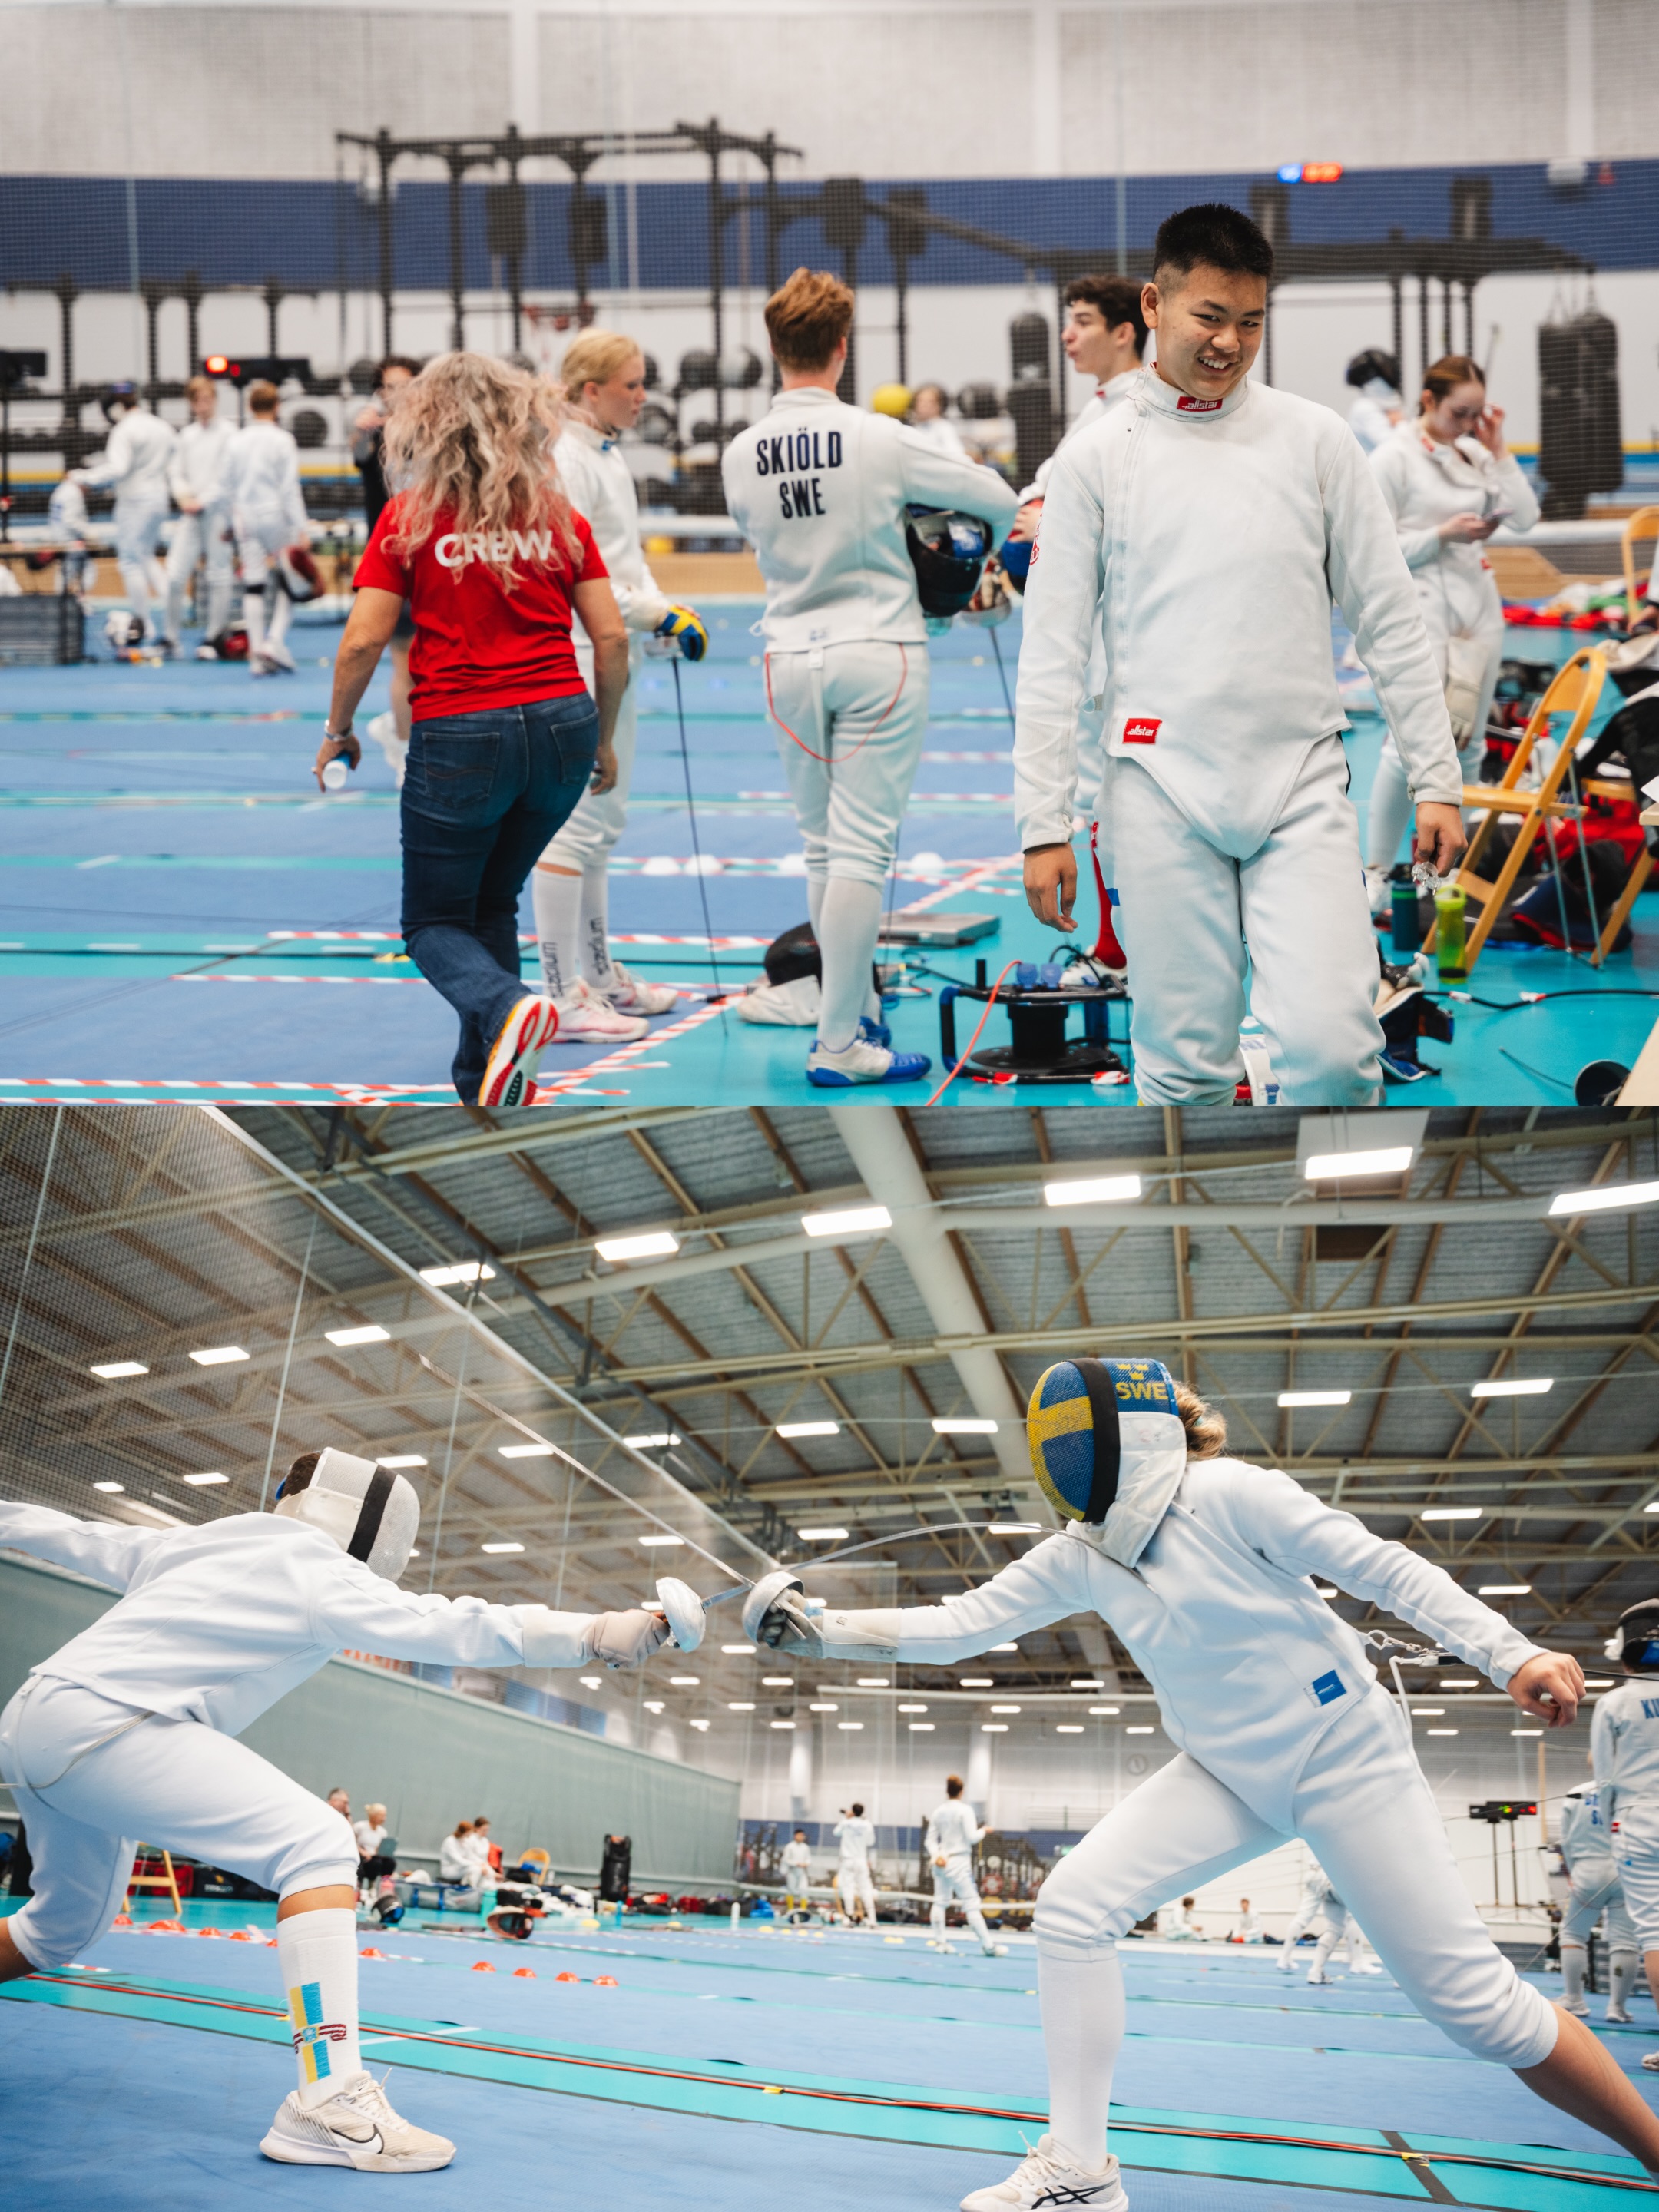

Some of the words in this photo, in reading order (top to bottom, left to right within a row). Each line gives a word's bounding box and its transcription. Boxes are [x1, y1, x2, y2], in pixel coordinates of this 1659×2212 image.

[1187, 399, 1219, 409] allstar
[757, 427, 842, 476] SKIÖLD
[780, 478, 826, 519] SWE
[435, 530, 553, 567] CREW
[1128, 724, 1155, 737] allstar
[1116, 1381, 1168, 1400] SWE
